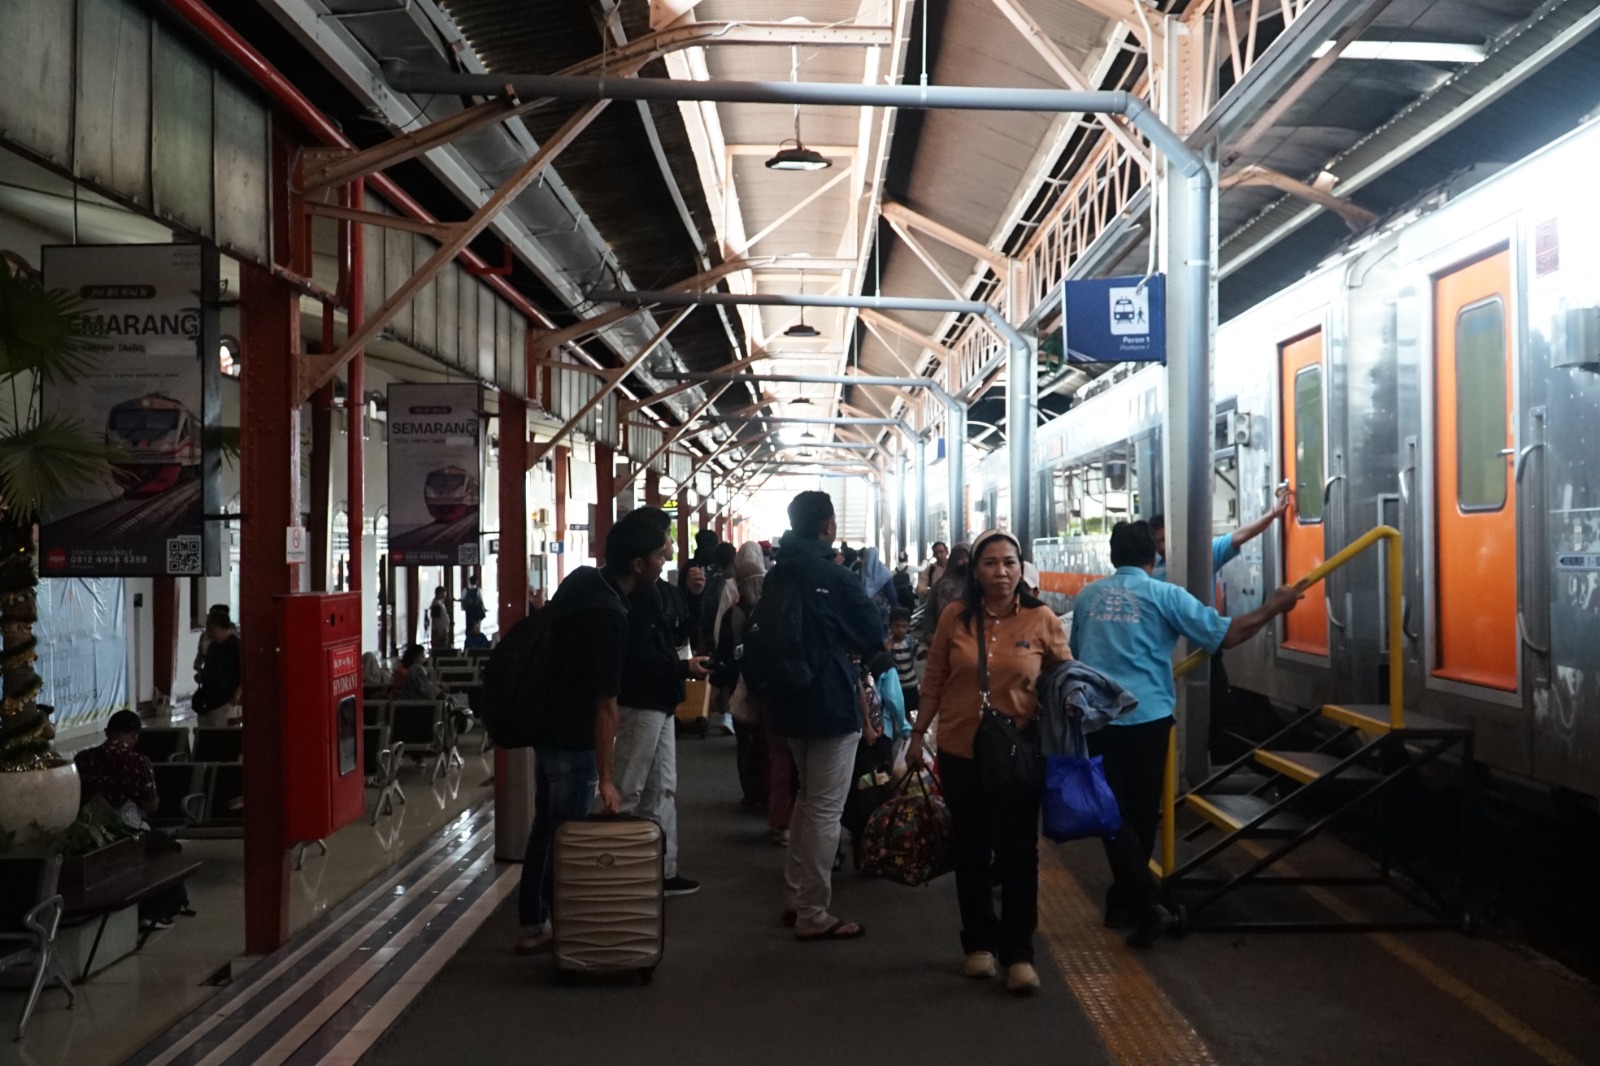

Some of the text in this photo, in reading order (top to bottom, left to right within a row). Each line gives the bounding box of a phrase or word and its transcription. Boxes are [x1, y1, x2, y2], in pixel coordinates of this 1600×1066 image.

[1122, 336, 1145, 344] Peron
[392, 422, 475, 434] SEMARANG
[333, 671, 358, 696] HYDRANT
